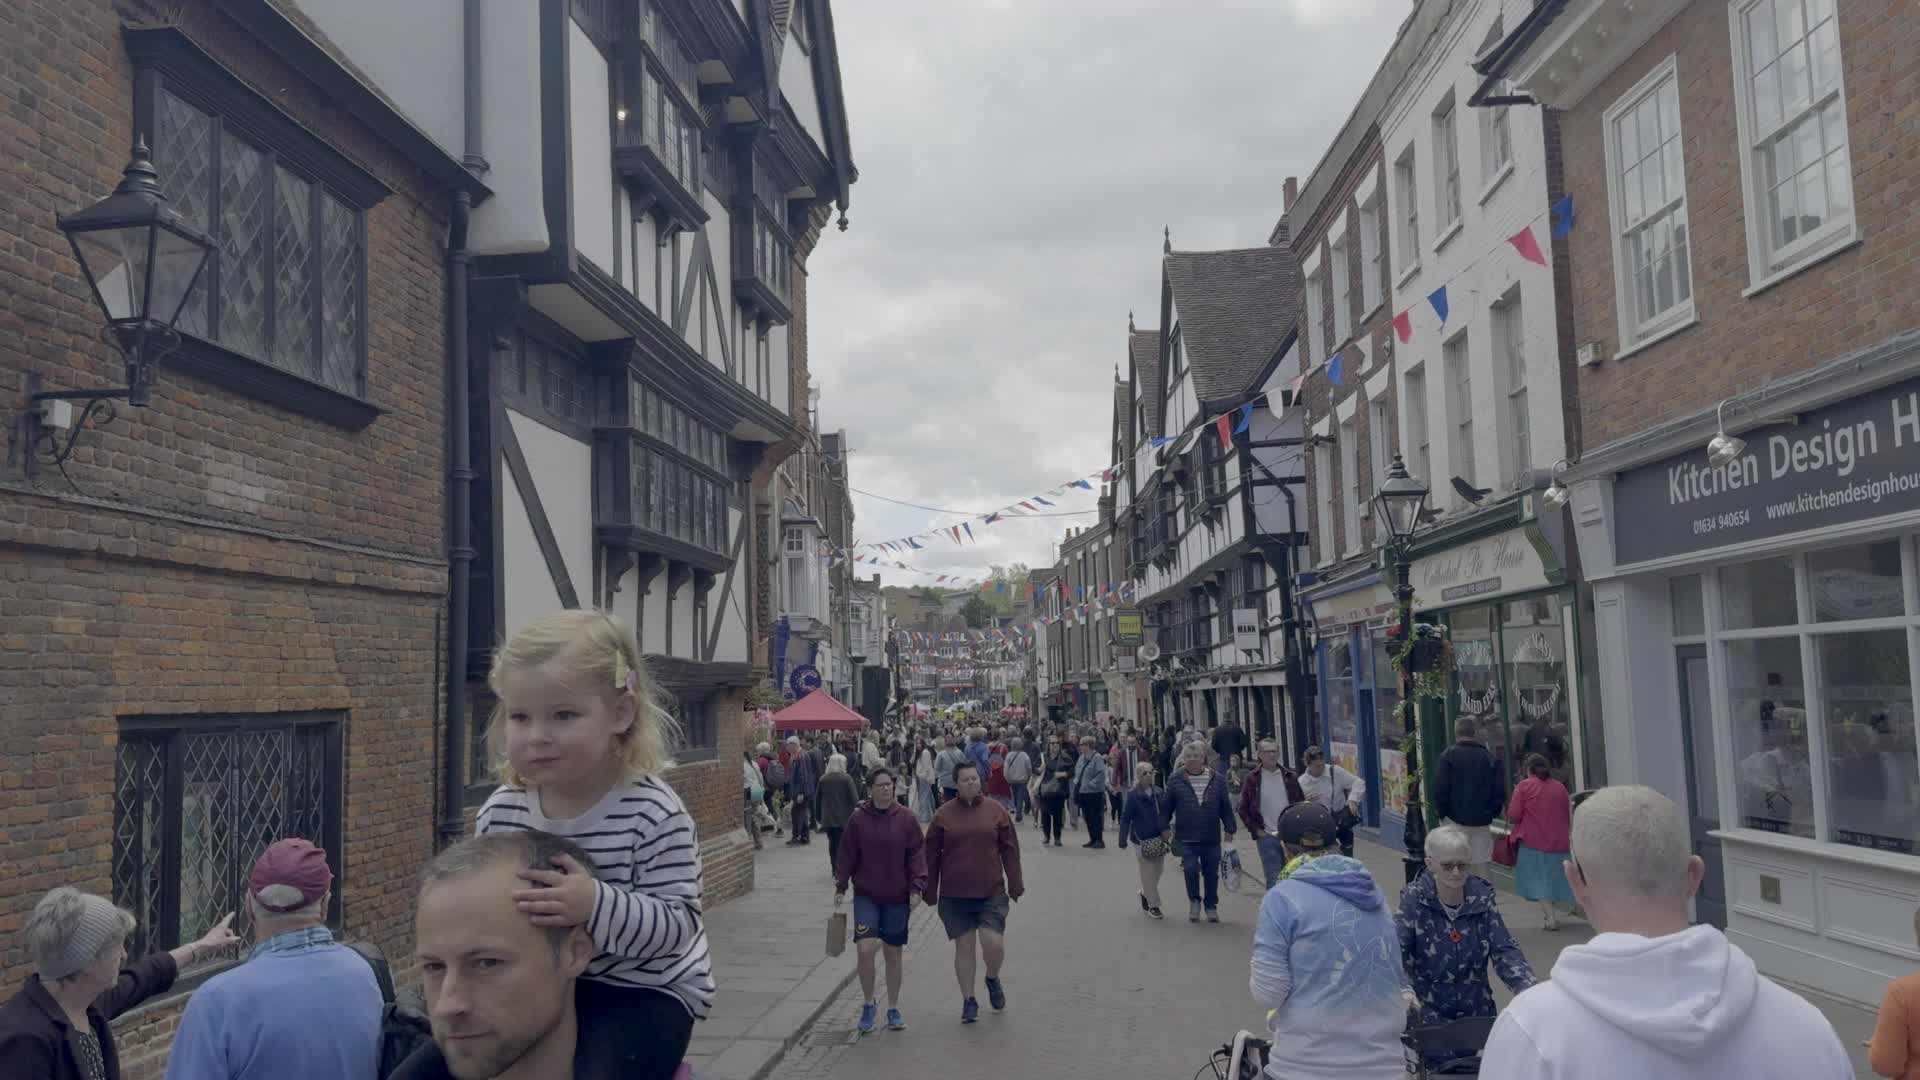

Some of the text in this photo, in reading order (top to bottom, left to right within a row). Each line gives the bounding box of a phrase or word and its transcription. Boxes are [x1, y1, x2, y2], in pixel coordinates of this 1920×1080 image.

[1668, 453, 1760, 505] Kitchen
[1769, 418, 1878, 480] Design
[1693, 471, 1920, 535] 01634 940654 www.kitchendesignhou
